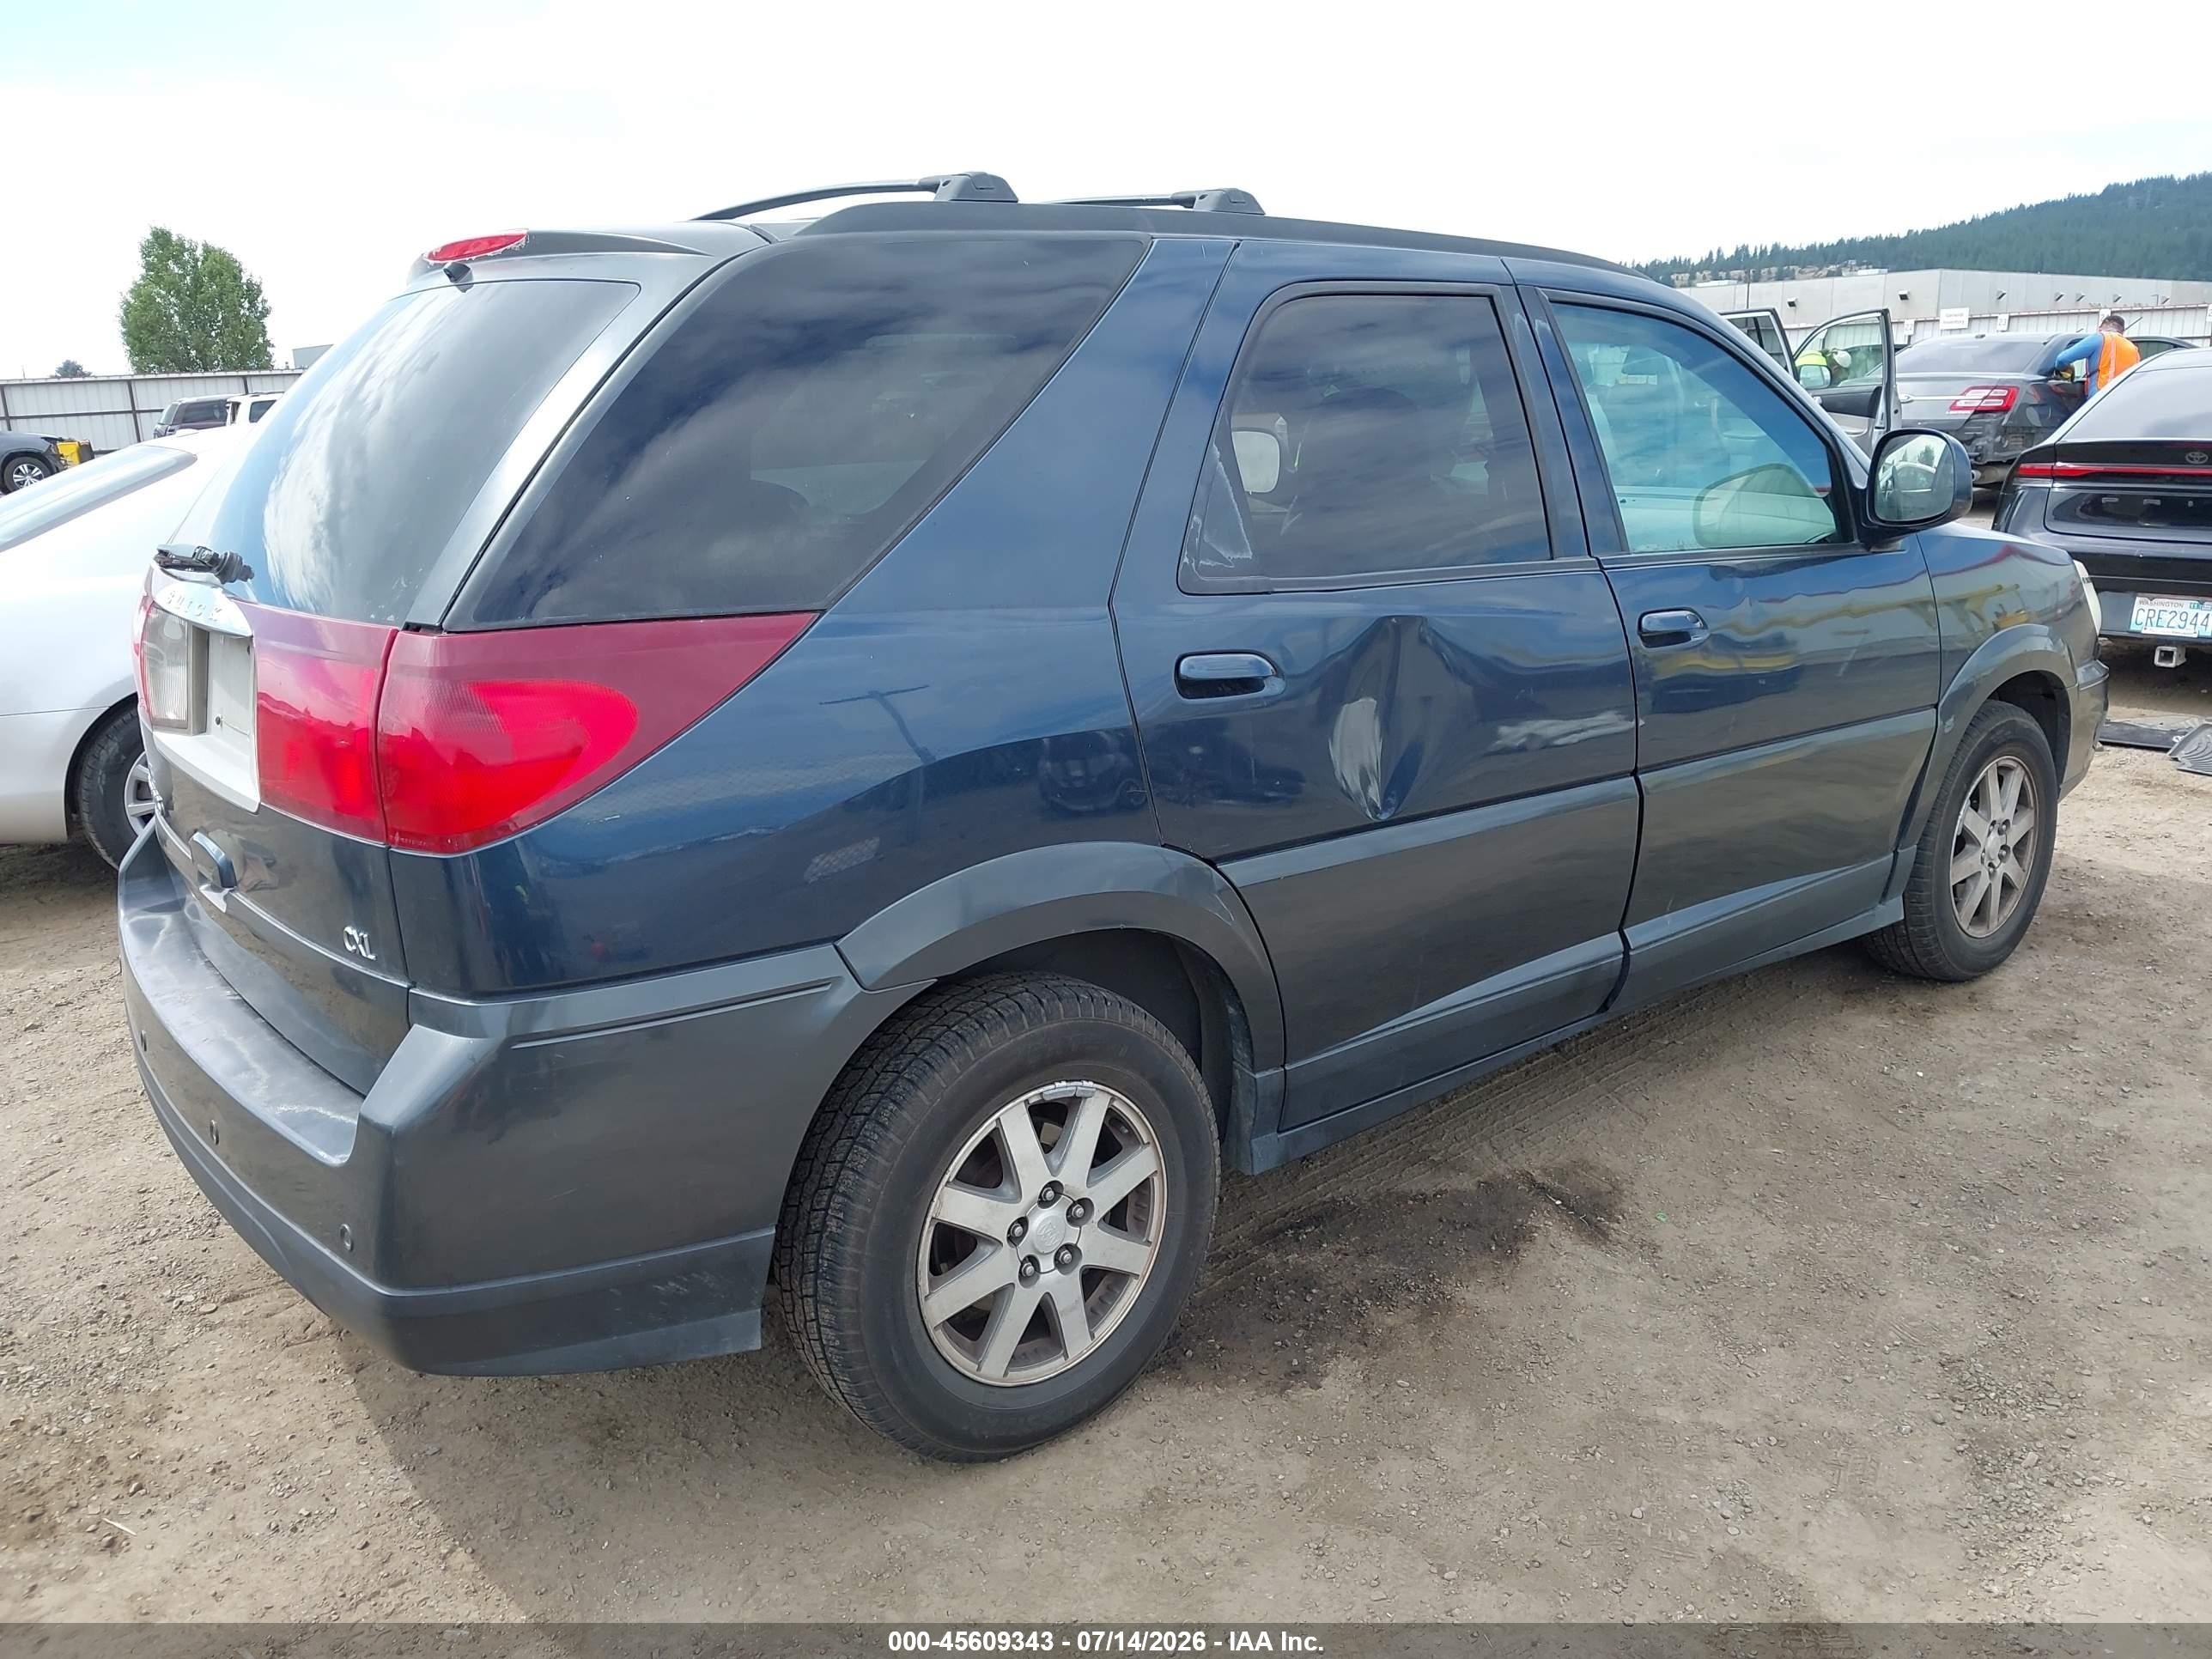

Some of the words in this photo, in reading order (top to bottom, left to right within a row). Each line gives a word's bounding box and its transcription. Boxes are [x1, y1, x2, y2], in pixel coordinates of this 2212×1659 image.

[165, 590, 223, 623] BUICK
[2139, 600, 2185, 609] WASHINGTON
[2135, 608, 2210, 632] CRE2944
[343, 927, 377, 960] CXL
